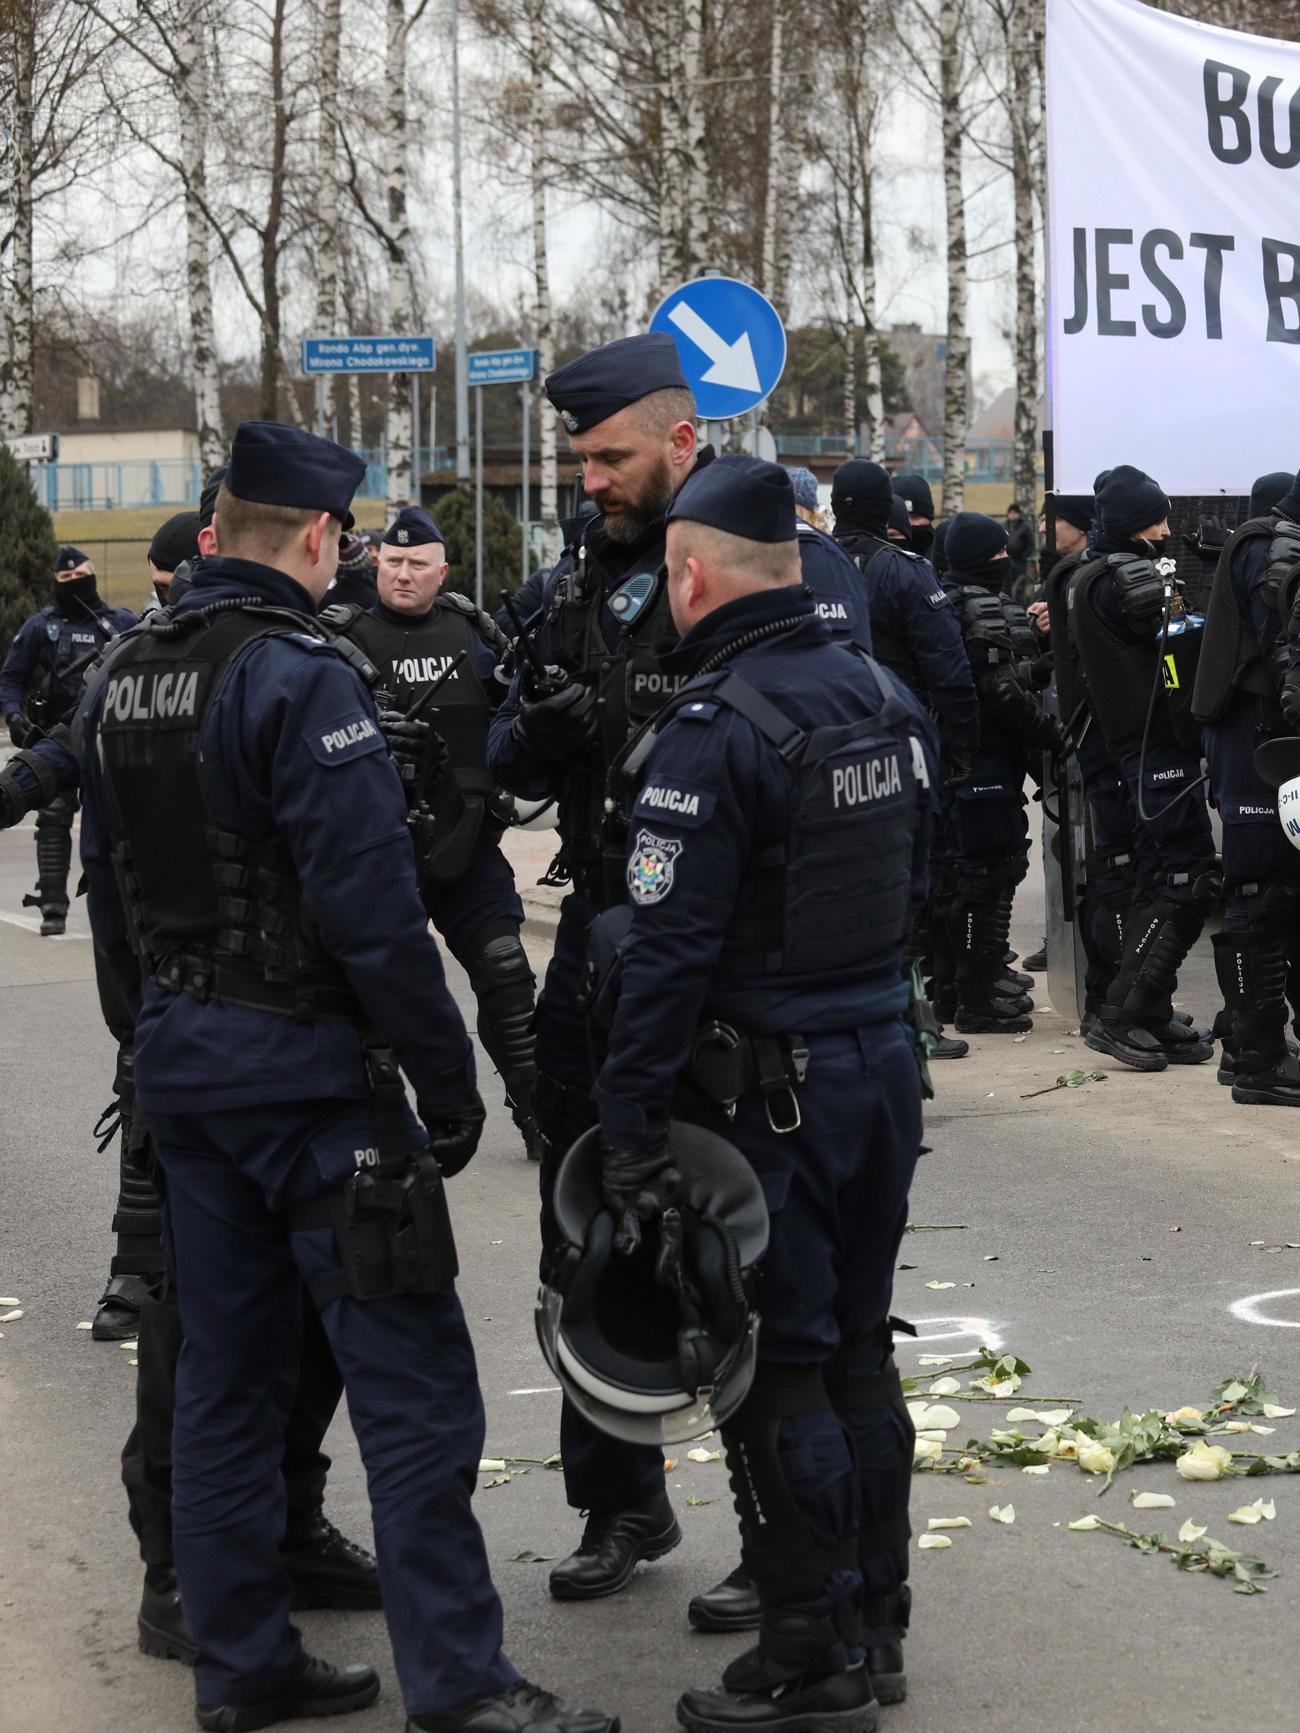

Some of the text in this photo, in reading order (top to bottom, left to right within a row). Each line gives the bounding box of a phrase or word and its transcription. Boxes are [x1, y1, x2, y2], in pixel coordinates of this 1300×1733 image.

[1063, 226, 1235, 340] JEST
[71, 633, 96, 644] POLICJA
[392, 656, 459, 685] POLICJA
[634, 673, 689, 695] POLI
[102, 671, 199, 724] POLICJA
[321, 719, 376, 753] POLICJA
[832, 754, 902, 808] POLICJA
[1153, 768, 1184, 781] POLICJA
[640, 786, 700, 816] POLICJA
[1239, 805, 1275, 815] POLICJA
[640, 834, 677, 854] POLICJA
[1135, 918, 1159, 953] POLICJA
[1236, 952, 1245, 994] POLICJA
